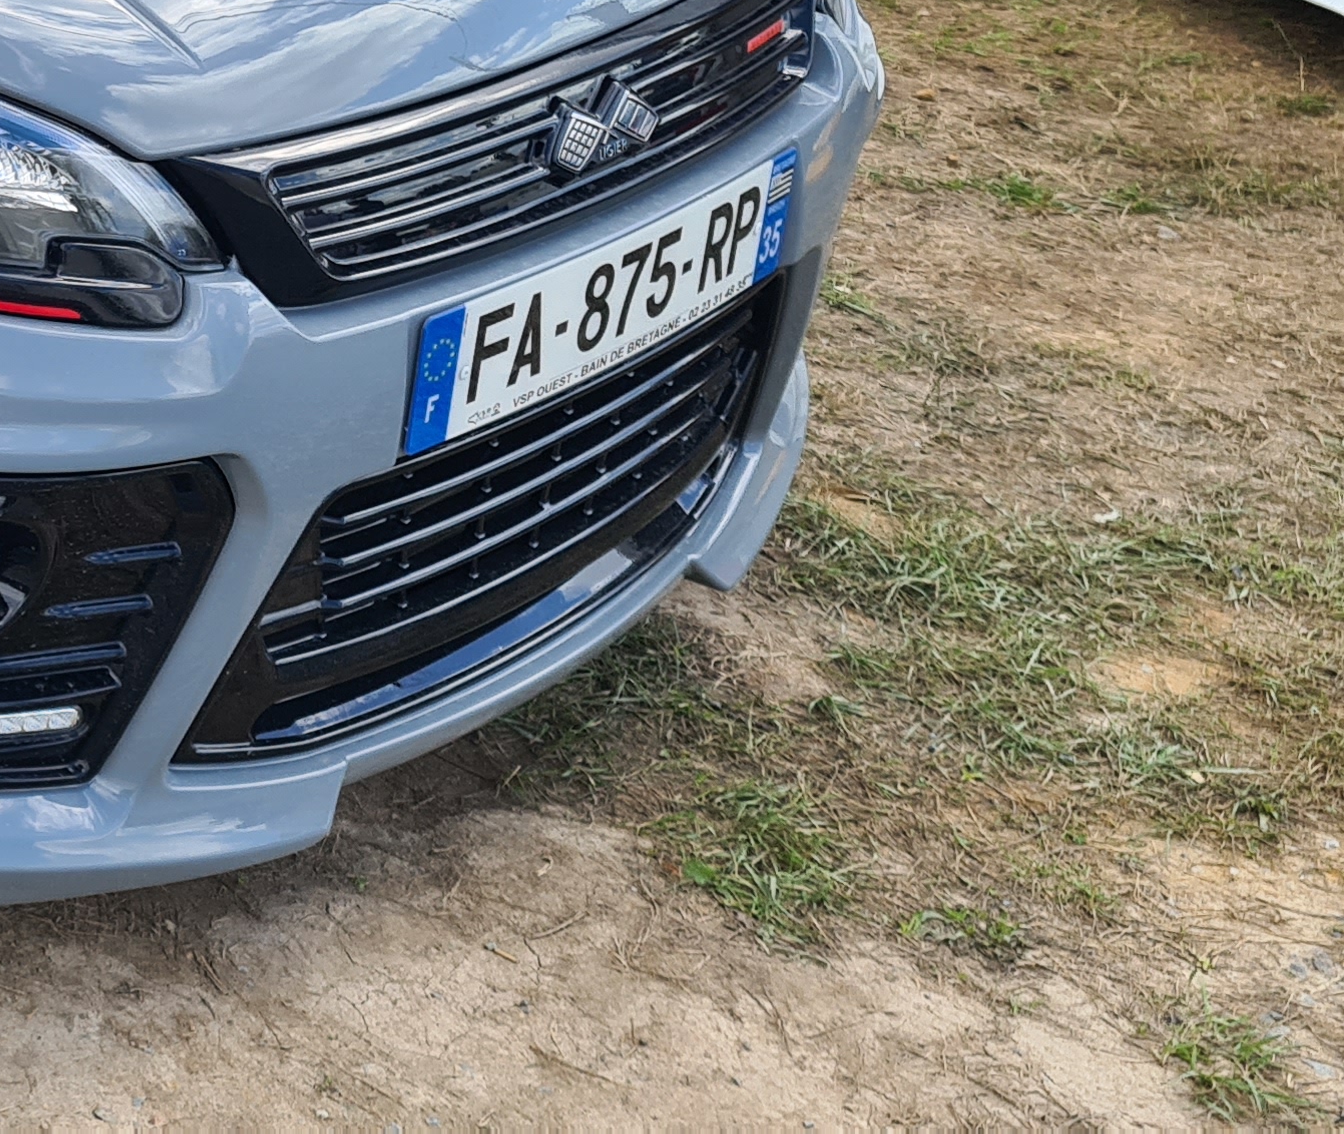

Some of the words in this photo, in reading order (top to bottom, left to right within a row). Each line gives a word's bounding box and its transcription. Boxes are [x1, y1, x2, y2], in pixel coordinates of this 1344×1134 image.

[598, 138, 628, 161] LIGIER
[758, 218, 784, 264] 35
[466, 186, 762, 405] FA-875-RP
[513, 389, 535, 408] VSP
[536, 371, 572, 397] OUEST
[581, 354, 608, 378] BAIN
[609, 346, 624, 363] DE
[626, 316, 681, 354] BRETAGNE
[424, 394, 440, 423] F
